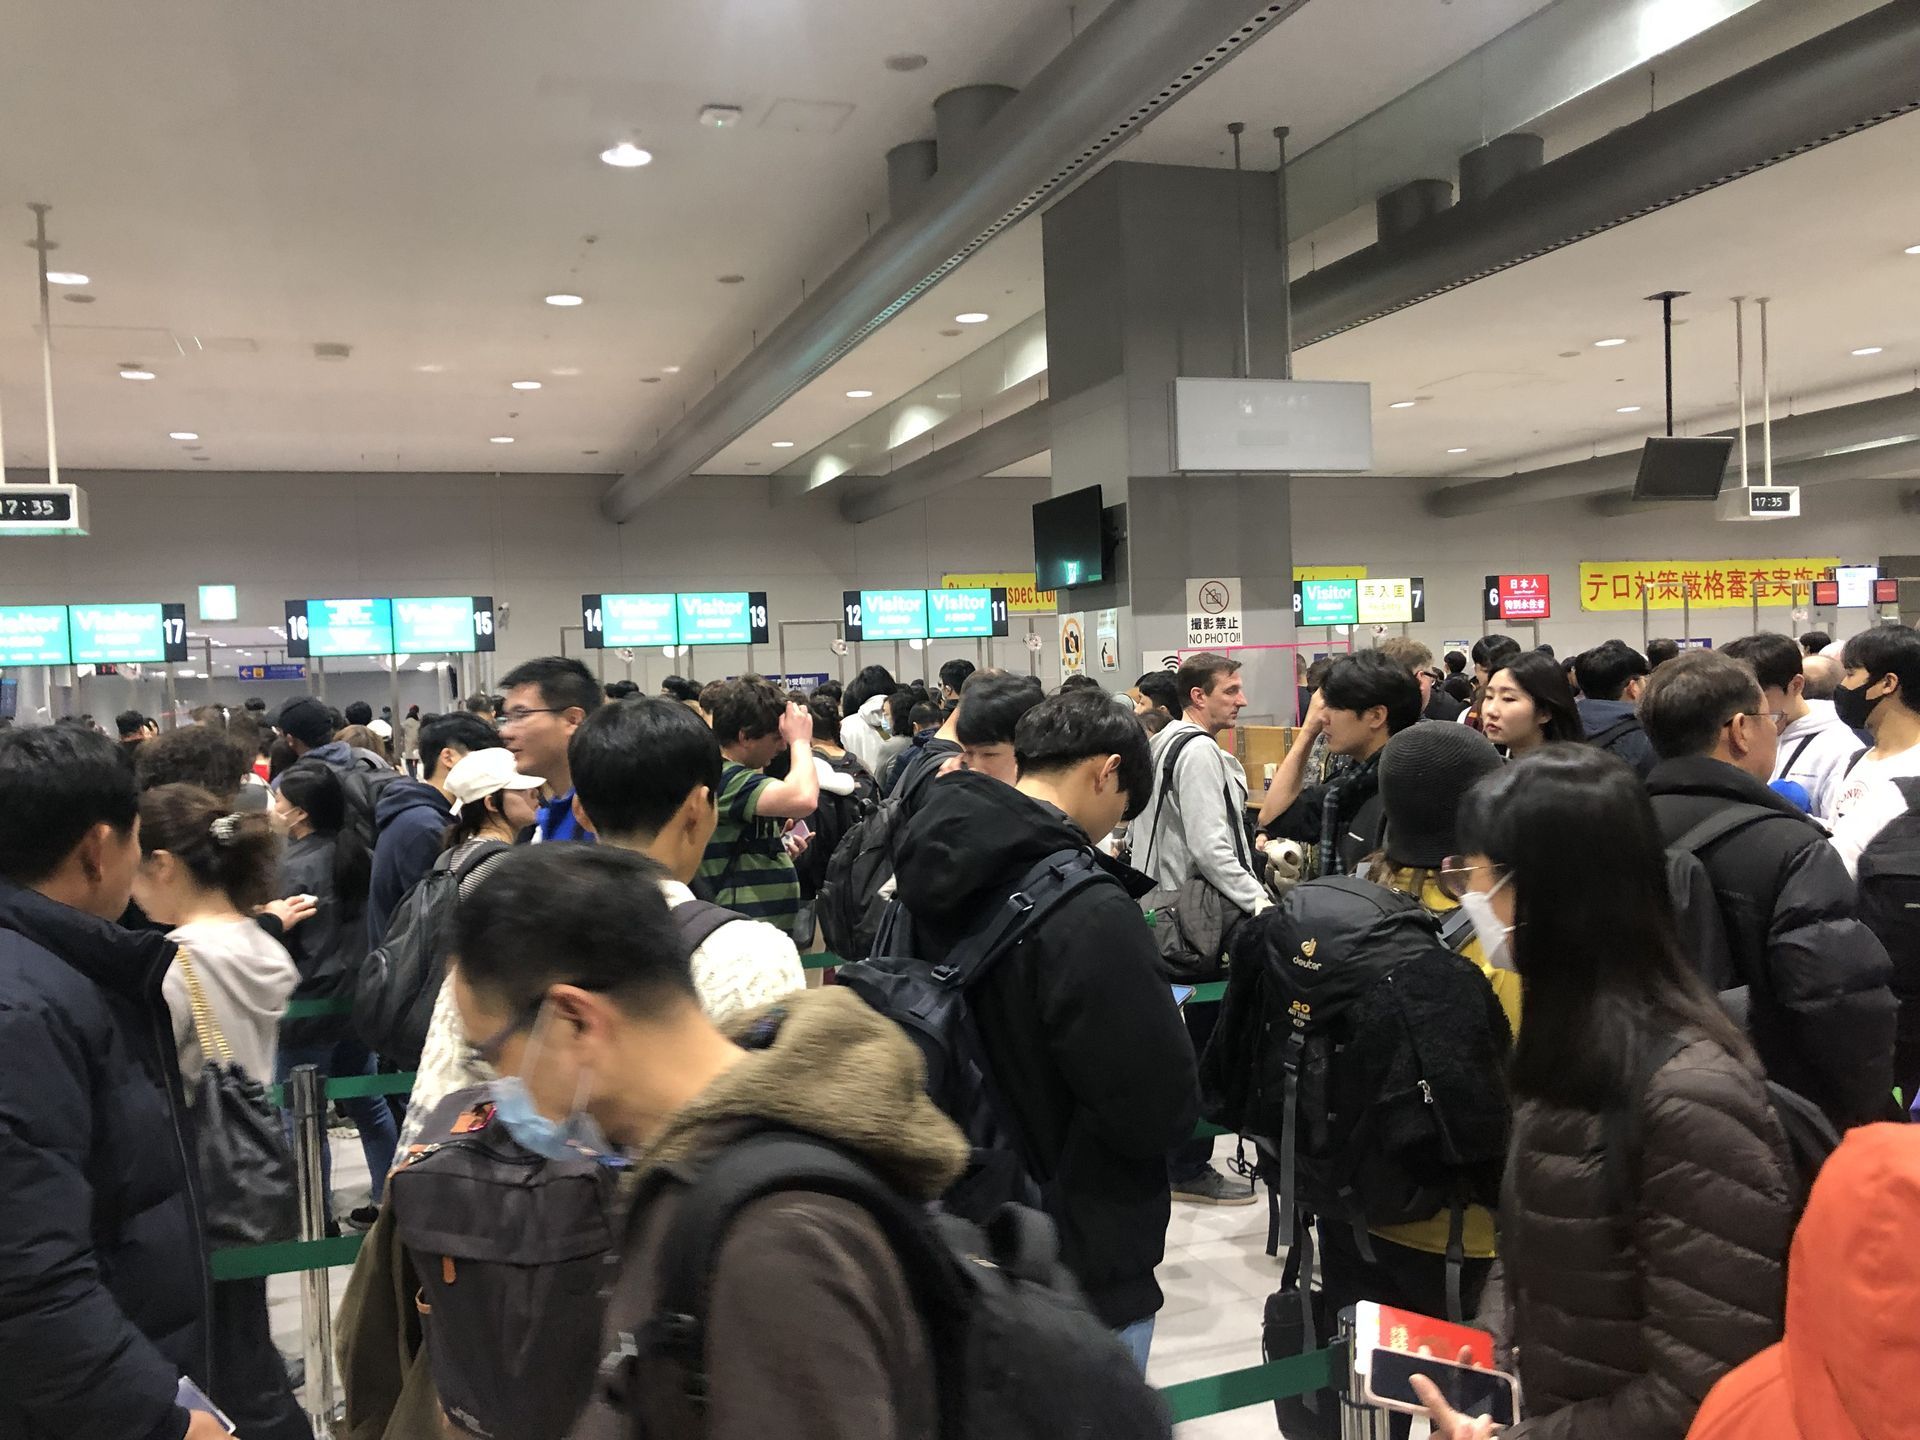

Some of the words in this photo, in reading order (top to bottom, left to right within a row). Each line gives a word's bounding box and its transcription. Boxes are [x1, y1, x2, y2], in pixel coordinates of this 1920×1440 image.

[1755, 497, 1782, 507] 17:35
[1306, 585, 1353, 601] Visitor
[1510, 579, 1539, 589] 日本人
[866, 595, 922, 613] Visitor
[932, 593, 986, 610] Visitor
[1411, 590, 1422, 609] 7
[1489, 588, 1499, 606] 6
[681, 598, 744, 616] Visitor
[845, 604, 861, 626] 12
[992, 600, 1006, 622] 11
[473, 611, 492, 635] 15
[585, 608, 602, 632] 14
[750, 605, 766, 628] 13
[1191, 616, 1239, 631] 撮影禁止
[163, 618, 184, 645] 17
[288, 616, 308, 640] 16
[1189, 633, 1202, 644] NO
[1204, 631, 1241, 644] PHOTO!!
[1292, 955, 1322, 971] deuter
[1292, 1000, 1311, 1014] 20
